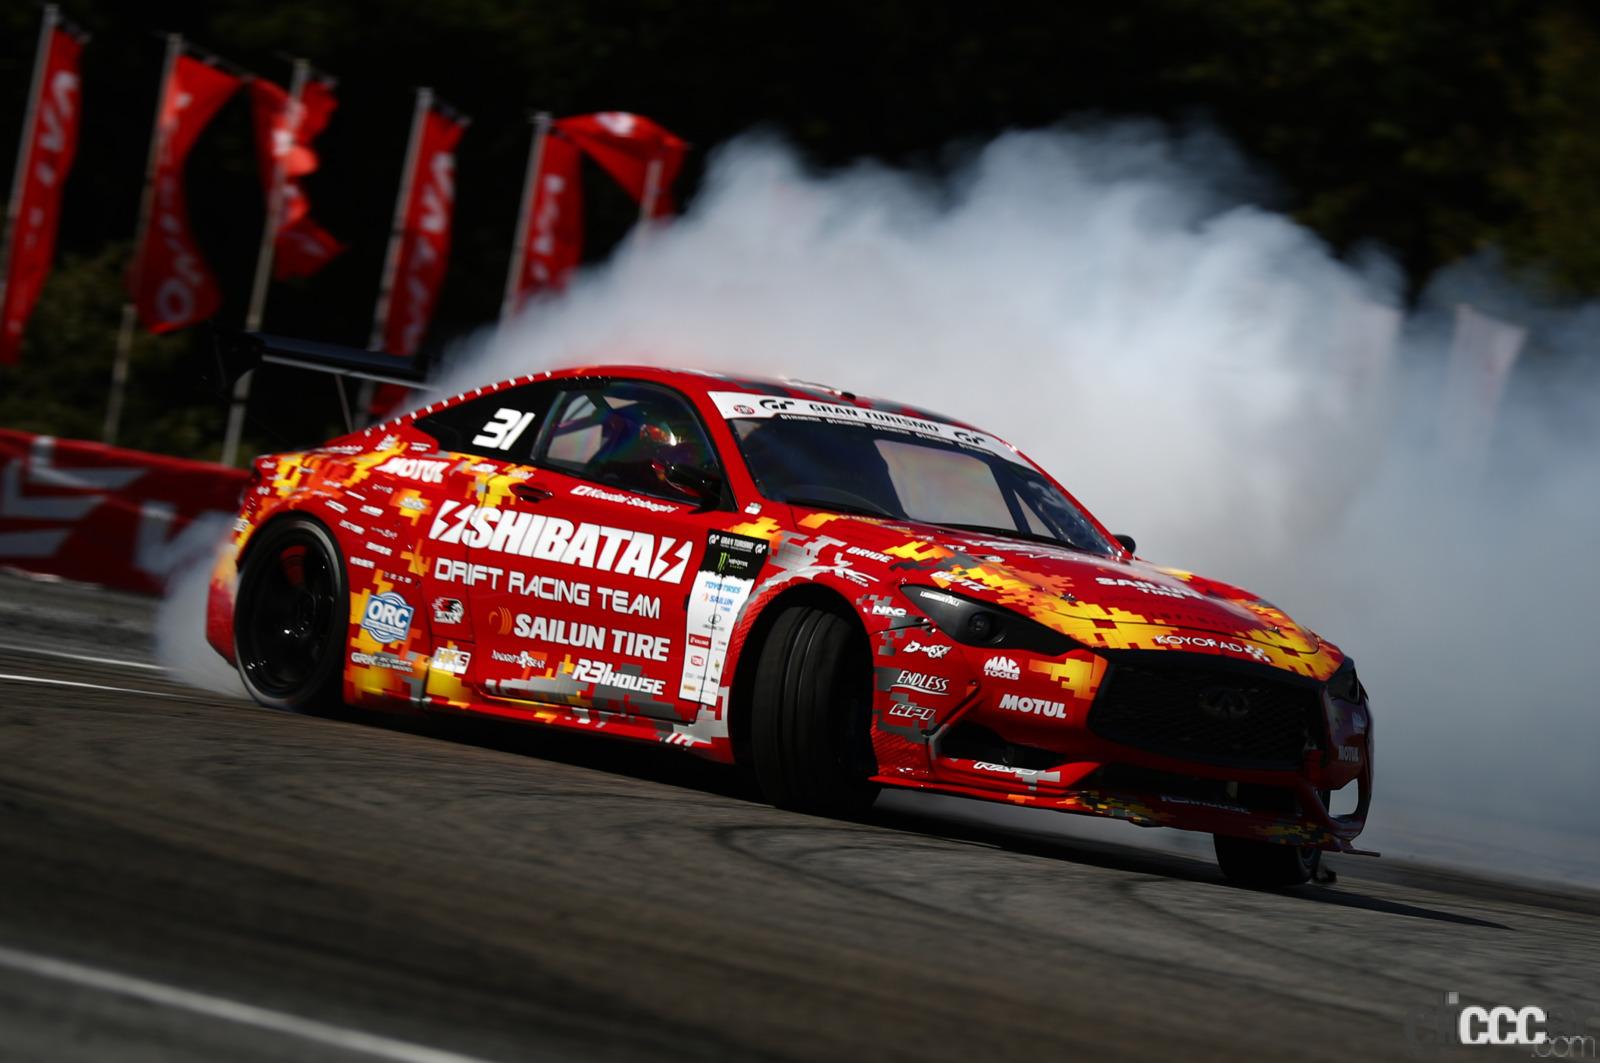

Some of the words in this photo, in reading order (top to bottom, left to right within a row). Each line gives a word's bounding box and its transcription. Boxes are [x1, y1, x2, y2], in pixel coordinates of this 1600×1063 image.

[472, 408, 535, 450] 31
[809, 403, 858, 418] GRAN
[862, 408, 941, 433] TURISMO
[375, 457, 451, 484] MOTUL
[461, 506, 655, 579] SHIBATA
[846, 546, 895, 563] BRIDE
[434, 557, 504, 590] DRIFT
[508, 571, 591, 607] RACING
[596, 586, 661, 619] TEAM
[367, 600, 409, 628] ORC
[513, 613, 607, 650] SAILUN
[611, 629, 671, 662] TIRE
[1155, 634, 1243, 653] KOYORAD
[984, 656, 1021, 675] MAC
[984, 669, 1020, 681] TOOLS
[896, 669, 950, 692] ENDLESS
[999, 693, 1067, 719] MOTUL
